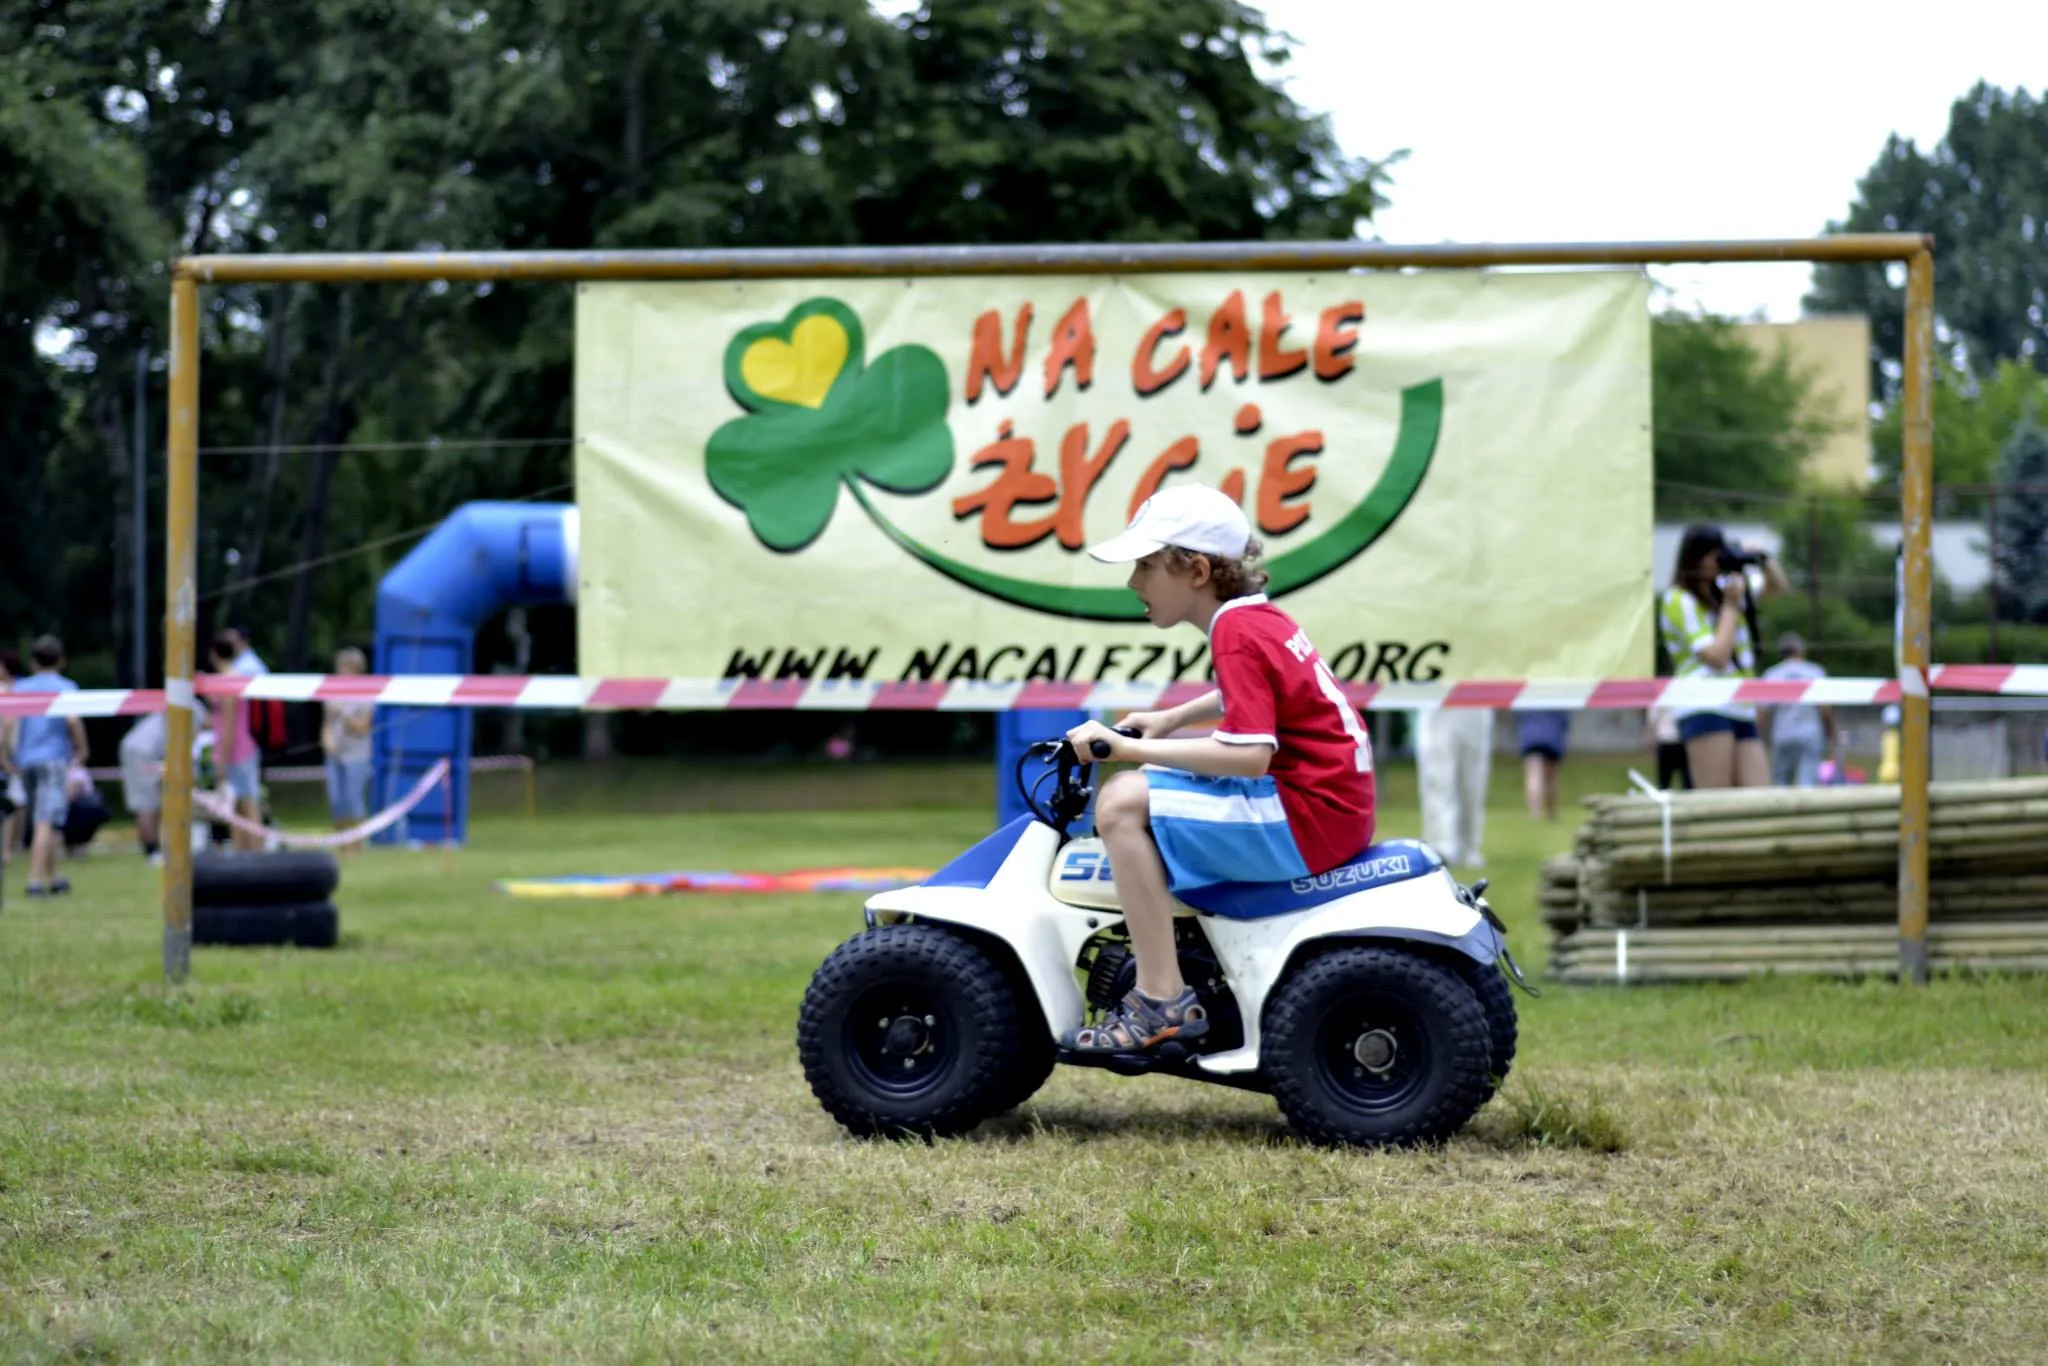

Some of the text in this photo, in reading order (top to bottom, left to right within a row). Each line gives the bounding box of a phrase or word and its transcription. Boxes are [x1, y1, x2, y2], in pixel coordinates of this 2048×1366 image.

[965, 288, 1366, 405] NA CAŁE
[1290, 855, 1411, 894] SUZUKI
